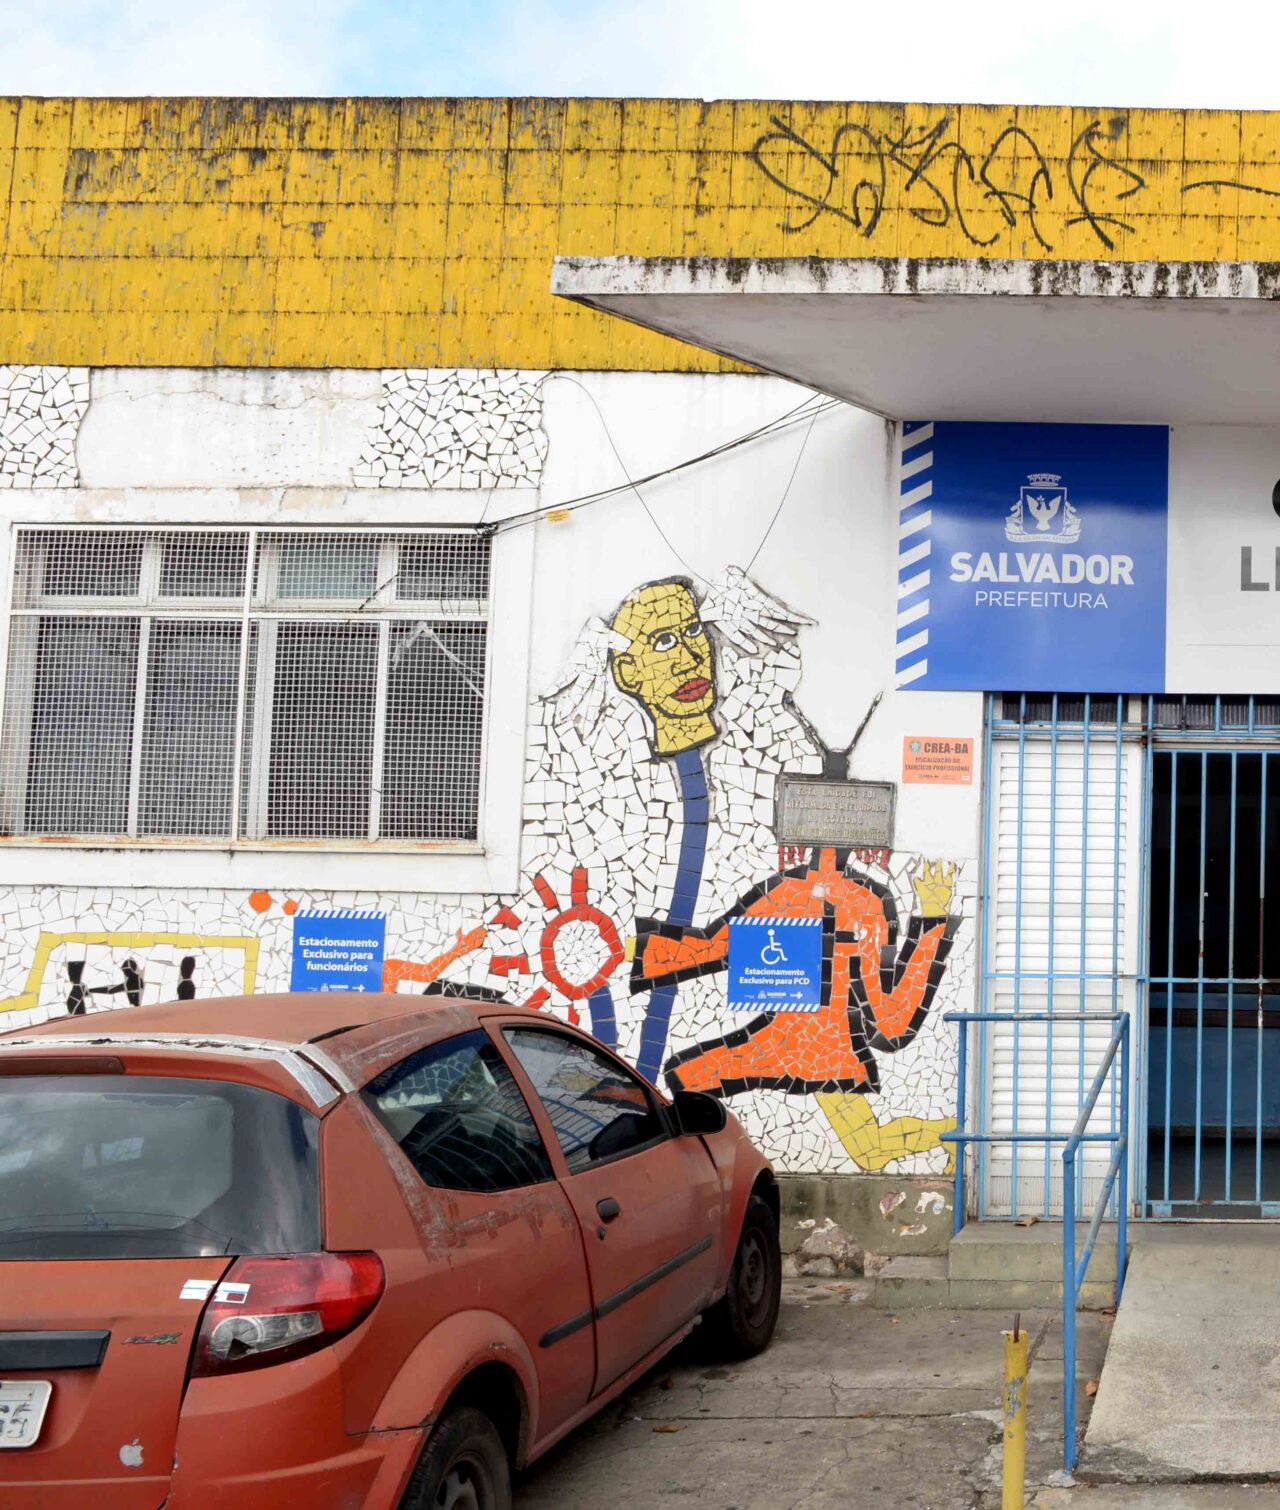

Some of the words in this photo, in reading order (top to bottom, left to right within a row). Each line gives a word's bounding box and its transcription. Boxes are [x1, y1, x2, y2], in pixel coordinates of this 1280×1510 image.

[949, 551, 1135, 585] SALVADOR
[975, 590, 1109, 608] PREFEITURA
[924, 742, 969, 754] CREA-BA
[299, 936, 379, 948] Estacionamento
[303, 949, 349, 959] Exclusivo
[350, 951, 374, 961] para
[306, 961, 369, 972] funcionários
[744, 968, 805, 976] Estacionamento
[739, 977, 774, 985] Exclusivo
[775, 978, 793, 986] para
[793, 977, 810, 985] PCD
